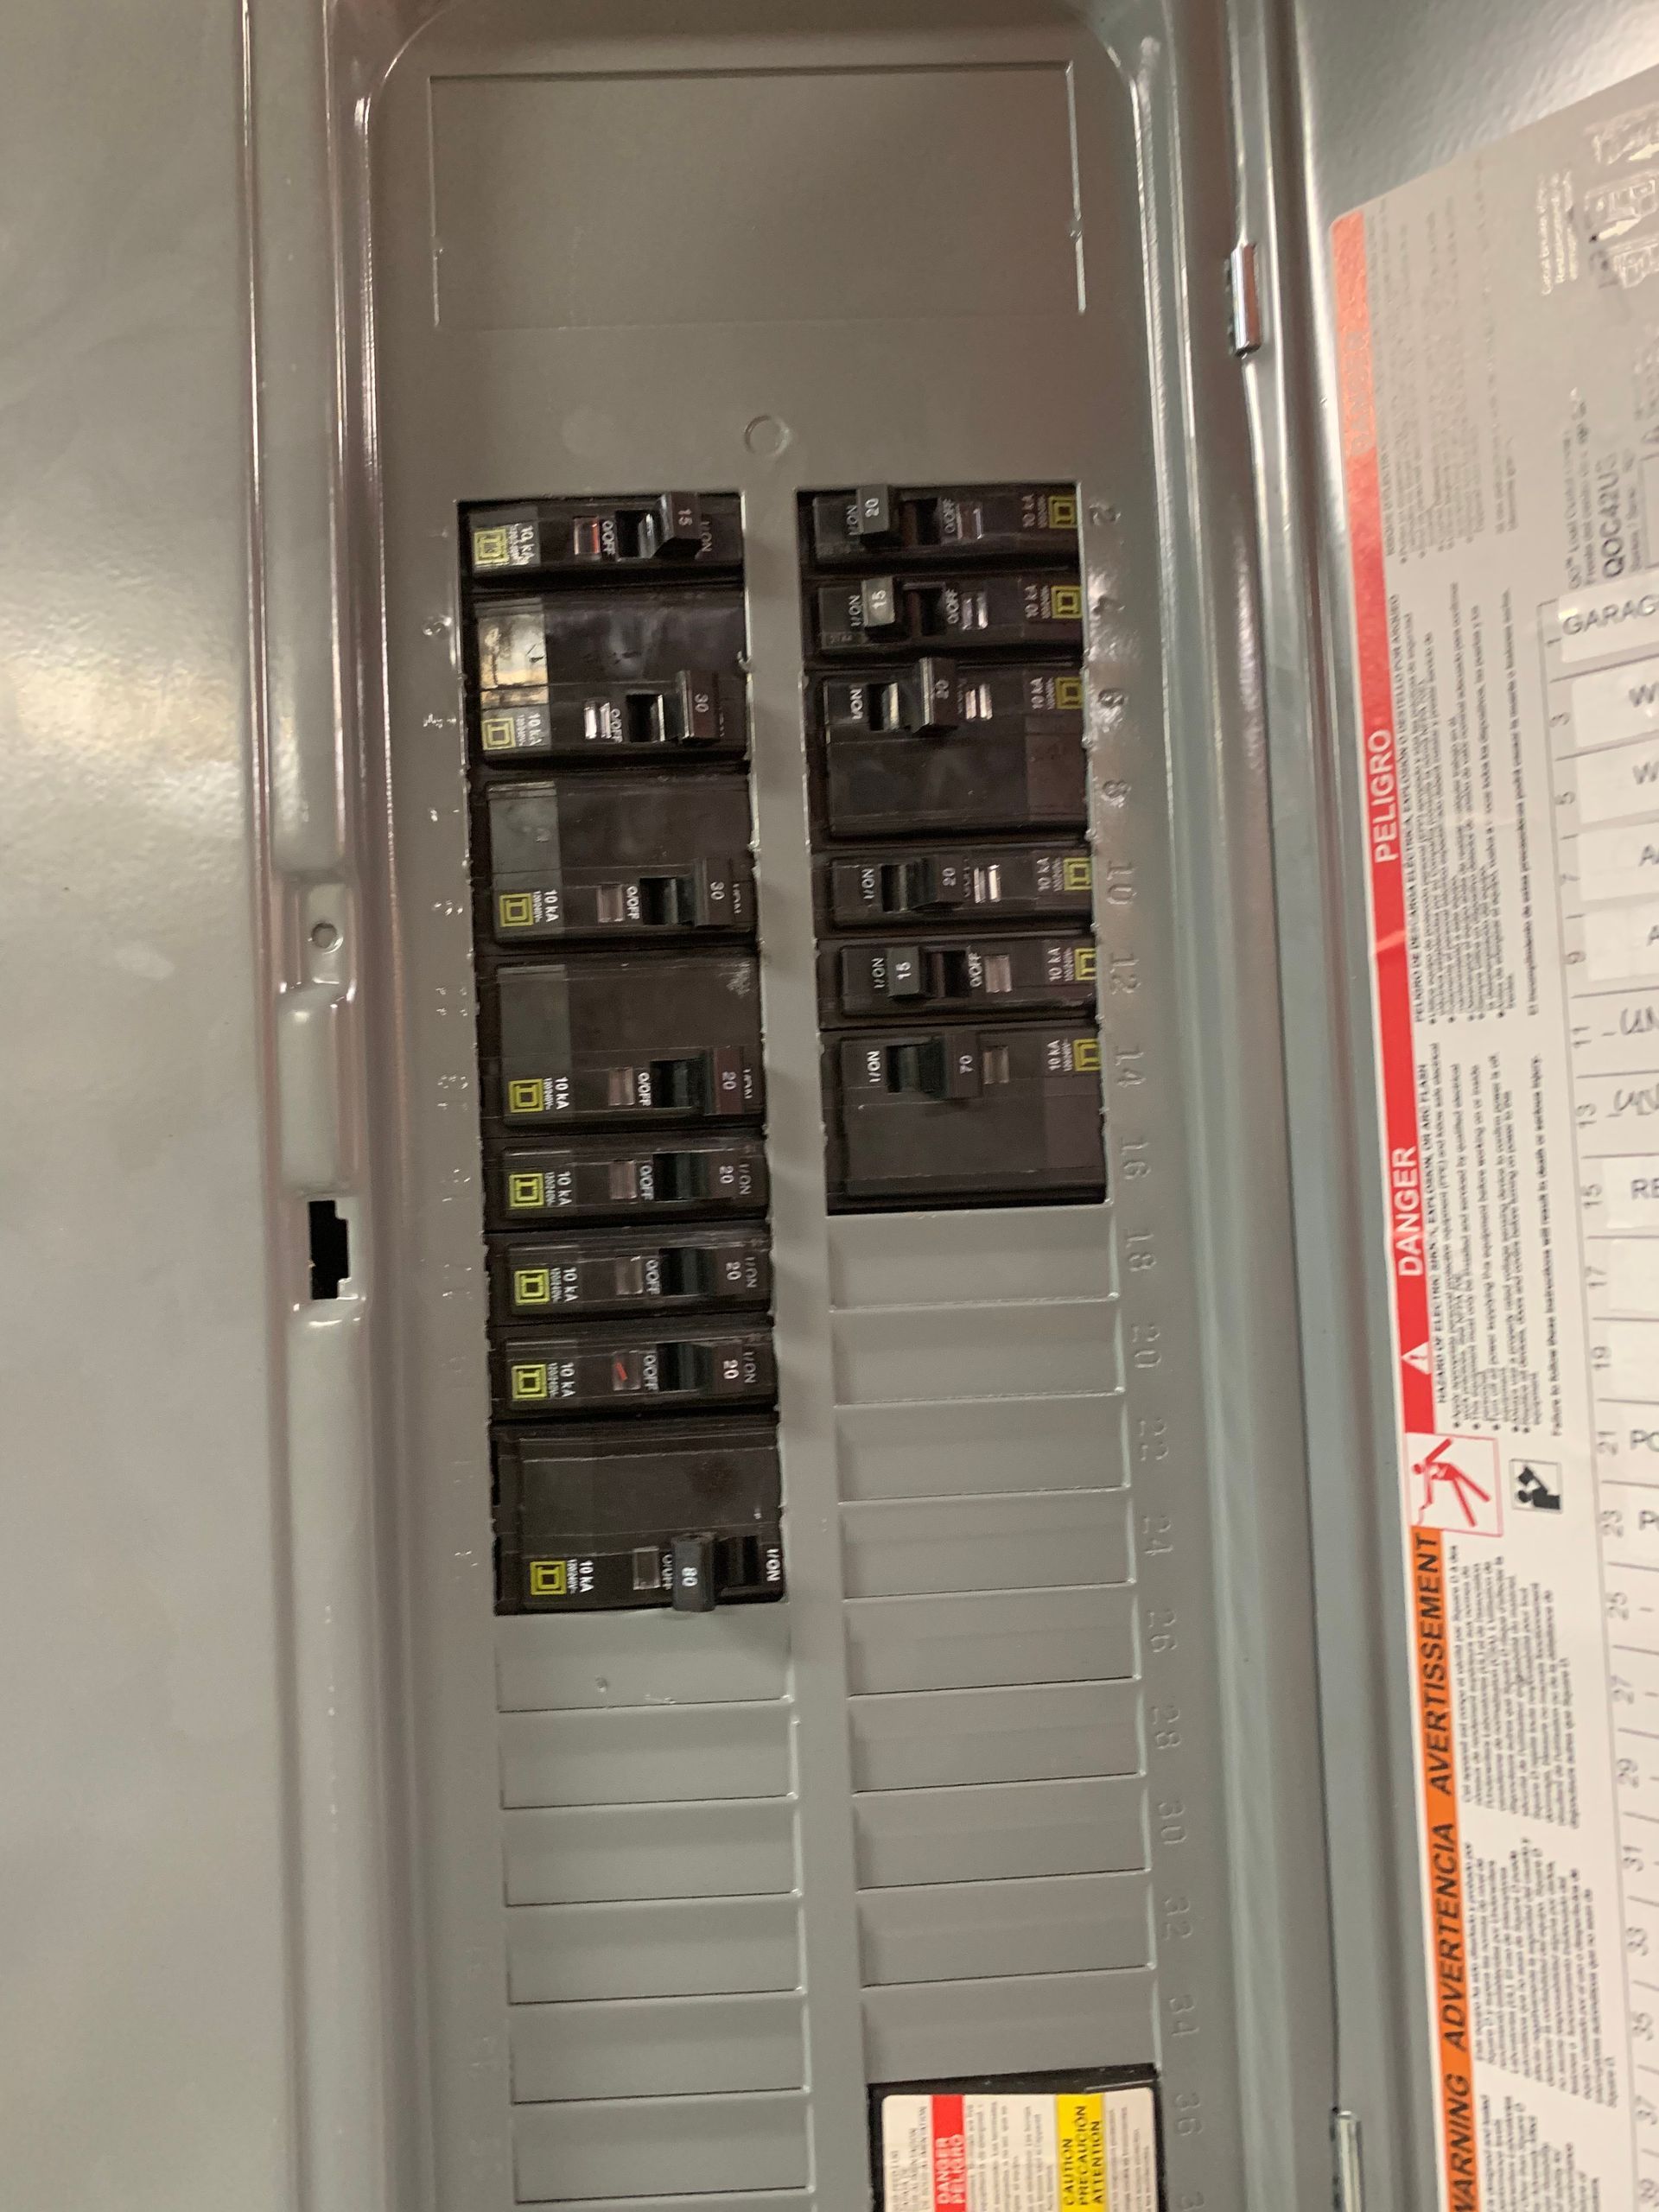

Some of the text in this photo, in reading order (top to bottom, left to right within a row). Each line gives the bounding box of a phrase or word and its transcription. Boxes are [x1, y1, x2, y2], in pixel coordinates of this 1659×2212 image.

[677, 508, 693, 526] 15
[865, 498, 880, 518] 20
[519, 524, 534, 542] 10
[870, 589, 887, 610] 15
[1024, 603, 1039, 619] 10
[695, 693, 709, 714] 30
[1031, 695, 1045, 709] 10
[528, 713, 543, 728] 10
[1548, 712, 1571, 728] 3
[1367, 728, 1400, 863] PELIGRO
[1553, 791, 1575, 805] 5
[710, 880, 726, 900] 30
[861, 868, 876, 900] I/ON
[941, 867, 957, 887] 20
[1036, 876, 1052, 892] 10
[1106, 863, 1139, 907] 10
[544, 889, 560, 923] 10 kA
[626, 885, 640, 921] O/OFF
[871, 957, 887, 989] I/ON
[895, 962, 912, 982] 15
[1047, 965, 1063, 982] 10
[1110, 953, 1142, 995] 12
[1570, 1026, 1592, 1049] 11
[867, 1050, 882, 1084] I/ON
[958, 1053, 975, 1075] 70
[1046, 1055, 1062, 1071] 10
[1115, 1047, 1147, 1089] 14
[554, 1077, 569, 1110] 10 kA
[638, 1071, 652, 1108] O/OFF
[722, 1071, 737, 1090] 20
[1575, 1103, 1598, 1129] 13
[719, 1164, 734, 1185] 20
[1120, 1139, 1152, 1181] 16
[557, 1170, 572, 1207] 10 kA
[1580, 1183, 1603, 1210] 15
[1392, 1145, 1424, 1277] DANGER
[1126, 1230, 1158, 1273] 18
[563, 1266, 579, 1303] 10 kA
[726, 1260, 742, 1281] 20
[1585, 1265, 1607, 1289] 17
[1131, 1323, 1162, 1370] 20
[1589, 1346, 1611, 1371] 19
[560, 1362, 576, 1398] 10 kA
[723, 1358, 741, 1381] 20
[1138, 1418, 1169, 1463] 22
[1596, 1431, 1618, 1457] 21
[1141, 1515, 1175, 1556] 24
[1599, 1510, 1624, 1539] 23
[579, 1560, 594, 1593] 10 kA
[681, 1566, 699, 1588] 80
[766, 1547, 780, 1583] I/ON
[1605, 1592, 1630, 1621] 25
[1147, 1609, 1179, 1654] 26
[1415, 1532, 1452, 1796] AVERTISSEMENT
[1608, 1674, 1635, 1704] 27
[1151, 1706, 1183, 1751] 28
[1613, 1758, 1640, 1789] 29
[1157, 1802, 1190, 1847] 30
[1621, 1844, 1644, 1873] 31
[1161, 1897, 1194, 1942] 32
[1431, 1823, 1467, 2052] ADVERTENCIA
[1624, 1927, 1649, 1958] 33
[1167, 1993, 1202, 2038] 34
[1630, 2012, 1654, 2042] 35
[1173, 2092, 1205, 2139] 36
[1632, 2094, 1658, 2126] 37
[934, 2137, 952, 2205] DANGER
[948, 2133, 966, 2205] PELIGRO
[1061, 2138, 1076, 2207] CAUTION
[1071, 2106, 1090, 2207] PRECAUCIÓN
[1090, 2120, 1104, 2206] ATTENTION
